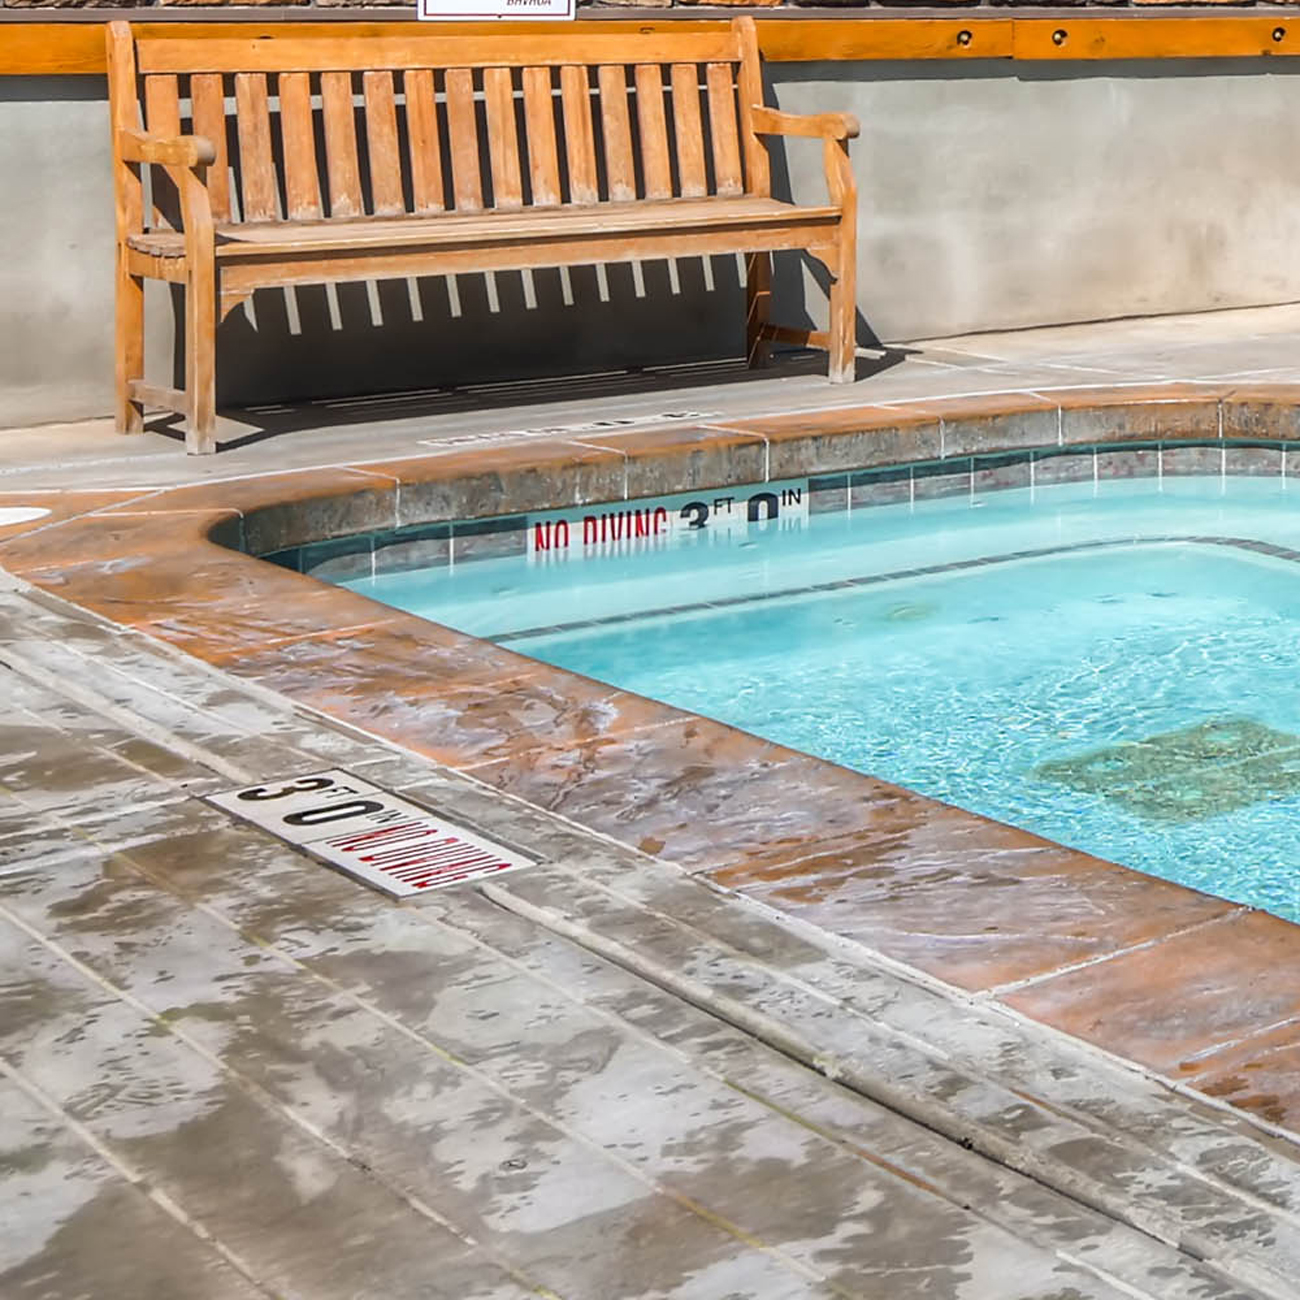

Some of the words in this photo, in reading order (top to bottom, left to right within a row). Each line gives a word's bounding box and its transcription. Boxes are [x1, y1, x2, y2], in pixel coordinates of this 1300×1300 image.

[535, 519, 569, 552] NO
[583, 507, 668, 546] DIVING
[679, 502, 709, 531] 3
[713, 496, 735, 516] FT
[782, 487, 801, 507] IN
[237, 777, 334, 801] 3
[283, 800, 386, 827] 0
